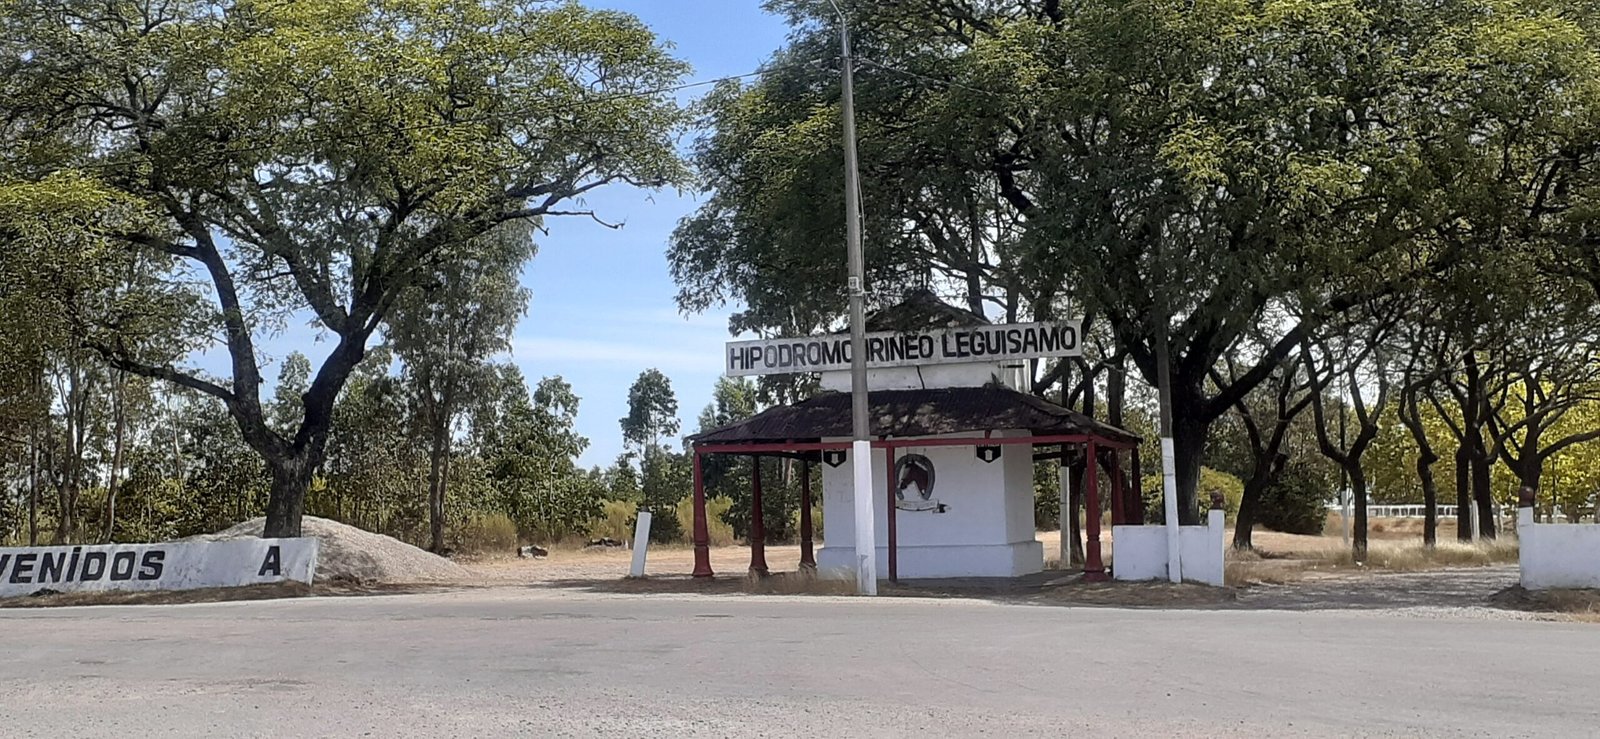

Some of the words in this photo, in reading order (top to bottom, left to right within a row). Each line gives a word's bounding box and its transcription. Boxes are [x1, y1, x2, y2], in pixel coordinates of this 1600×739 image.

[730, 339, 852, 370] HIPODROMO
[941, 326, 1076, 358] LEGUISAMO
[257, 545, 281, 576] A
